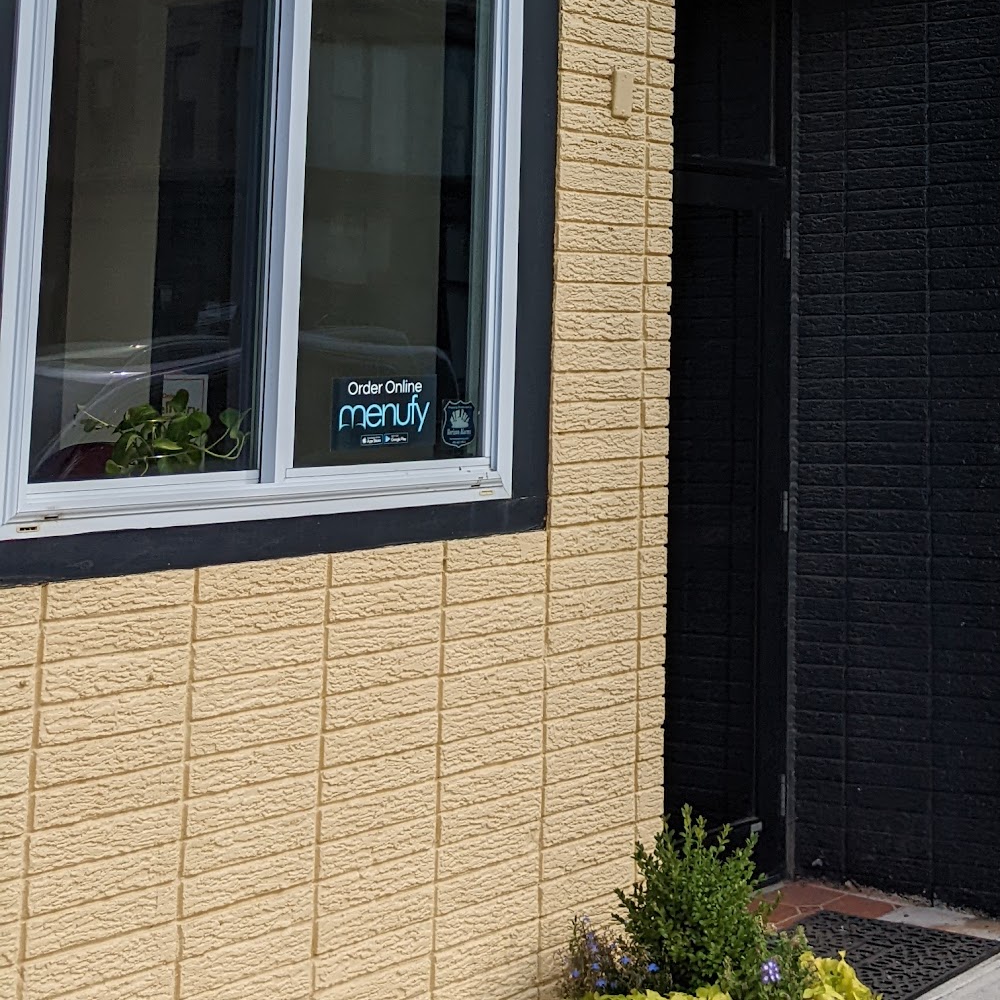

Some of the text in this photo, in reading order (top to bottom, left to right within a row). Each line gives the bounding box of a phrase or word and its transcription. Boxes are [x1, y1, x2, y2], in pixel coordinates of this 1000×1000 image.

[347, 379, 423, 395] Order Online
[338, 394, 430, 432] menufy
